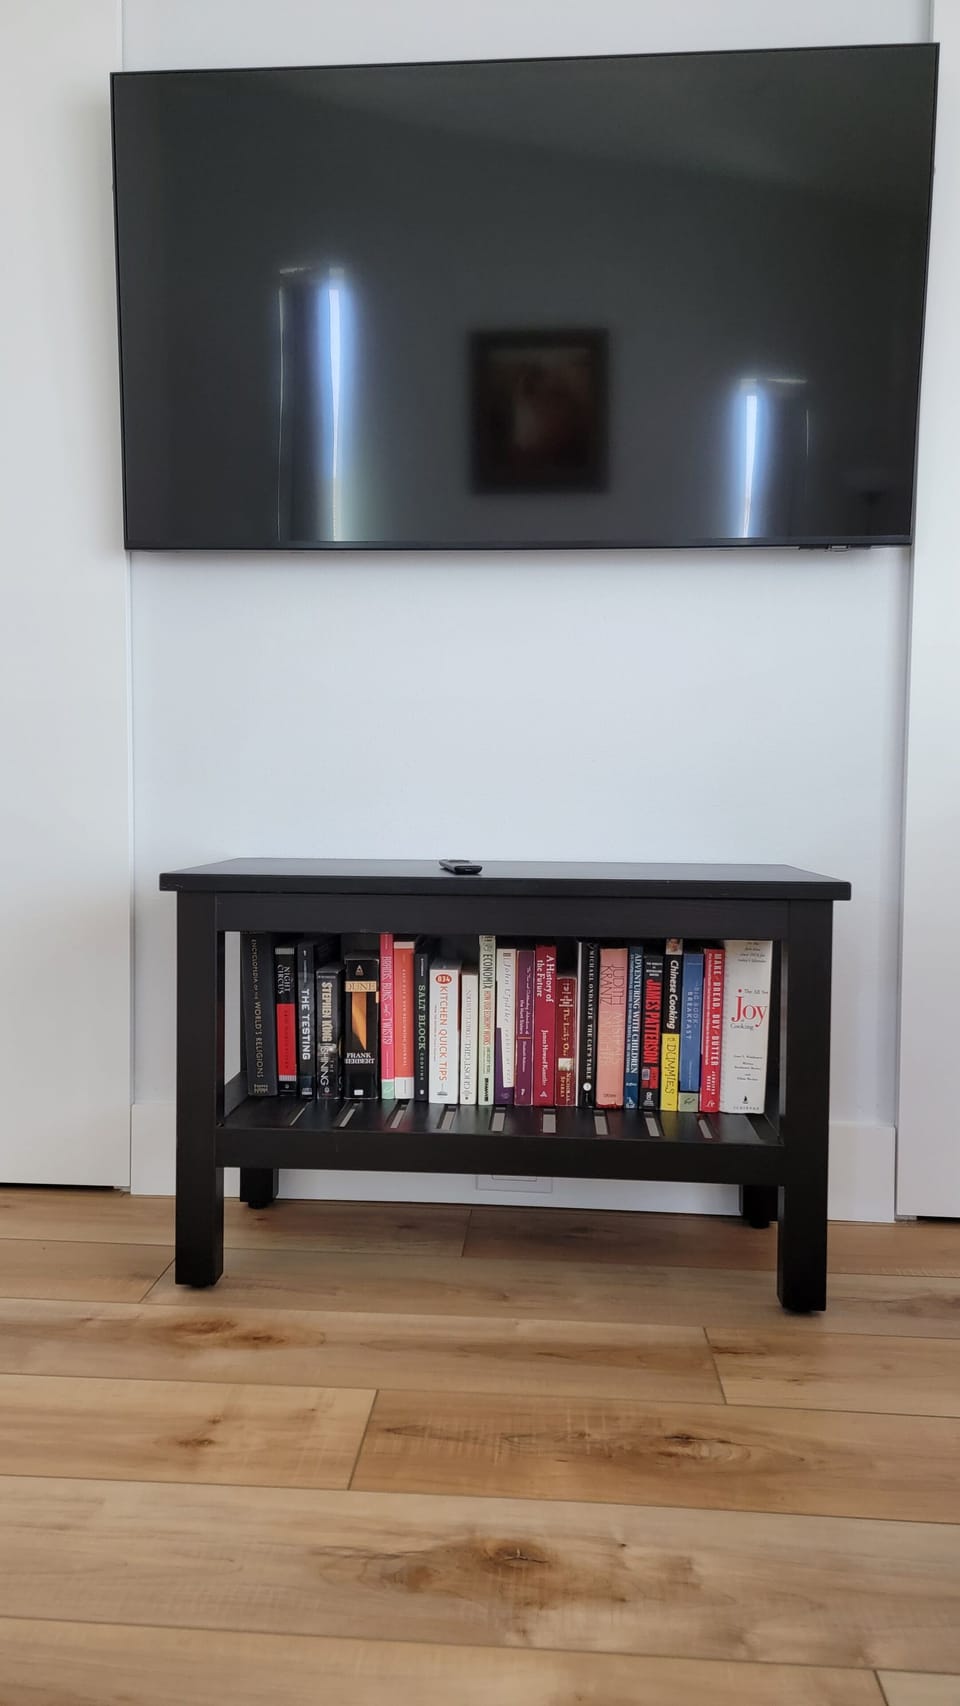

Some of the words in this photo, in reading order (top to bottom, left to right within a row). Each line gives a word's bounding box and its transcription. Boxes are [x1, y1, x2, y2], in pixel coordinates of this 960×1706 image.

[482, 954, 493, 989] ECONOMIX
[544, 963, 554, 993] History
[668, 960, 679, 993] Chinese
[714, 953, 722, 975] MAKE
[418, 984, 426, 1011] SALT
[536, 973, 544, 998] Future
[600, 965, 613, 1006] KRANTZ
[613, 966, 625, 1006] JUDITH
[633, 953, 642, 1009] ADVENTURING
[646, 979, 661, 1011] JAMES
[301, 988, 310, 1010] THE
[321, 982, 333, 1018] STEPHEN
[439, 986, 448, 1026] KITCHEN
[545, 994, 554, 1003] of
[666, 993, 678, 1030] Cooking
[254, 1001, 263, 1035] WORLD'S
[321, 1020, 333, 1042] KING
[418, 1014, 426, 1050] BLOCK
[632, 1010, 640, 1033] WITH
[685, 991, 693, 1040] BREAKFAST
[712, 1014, 720, 1029] BUY
[730, 1023, 754, 1031] Cooking
[301, 1014, 310, 1060] TESTING
[438, 1029, 448, 1058] QUICK
[540, 1030, 548, 1044] James
[644, 1012, 660, 1063] PATTERSON
[711, 1035, 719, 1066] BUTTER
[255, 1037, 264, 1078] RELIGIONS
[320, 1046, 329, 1086] SHINING
[631, 1034, 639, 1074] CHILDREN
[664, 1044, 676, 1094] DUMMIES
[439, 1061, 448, 1081] TIPS
